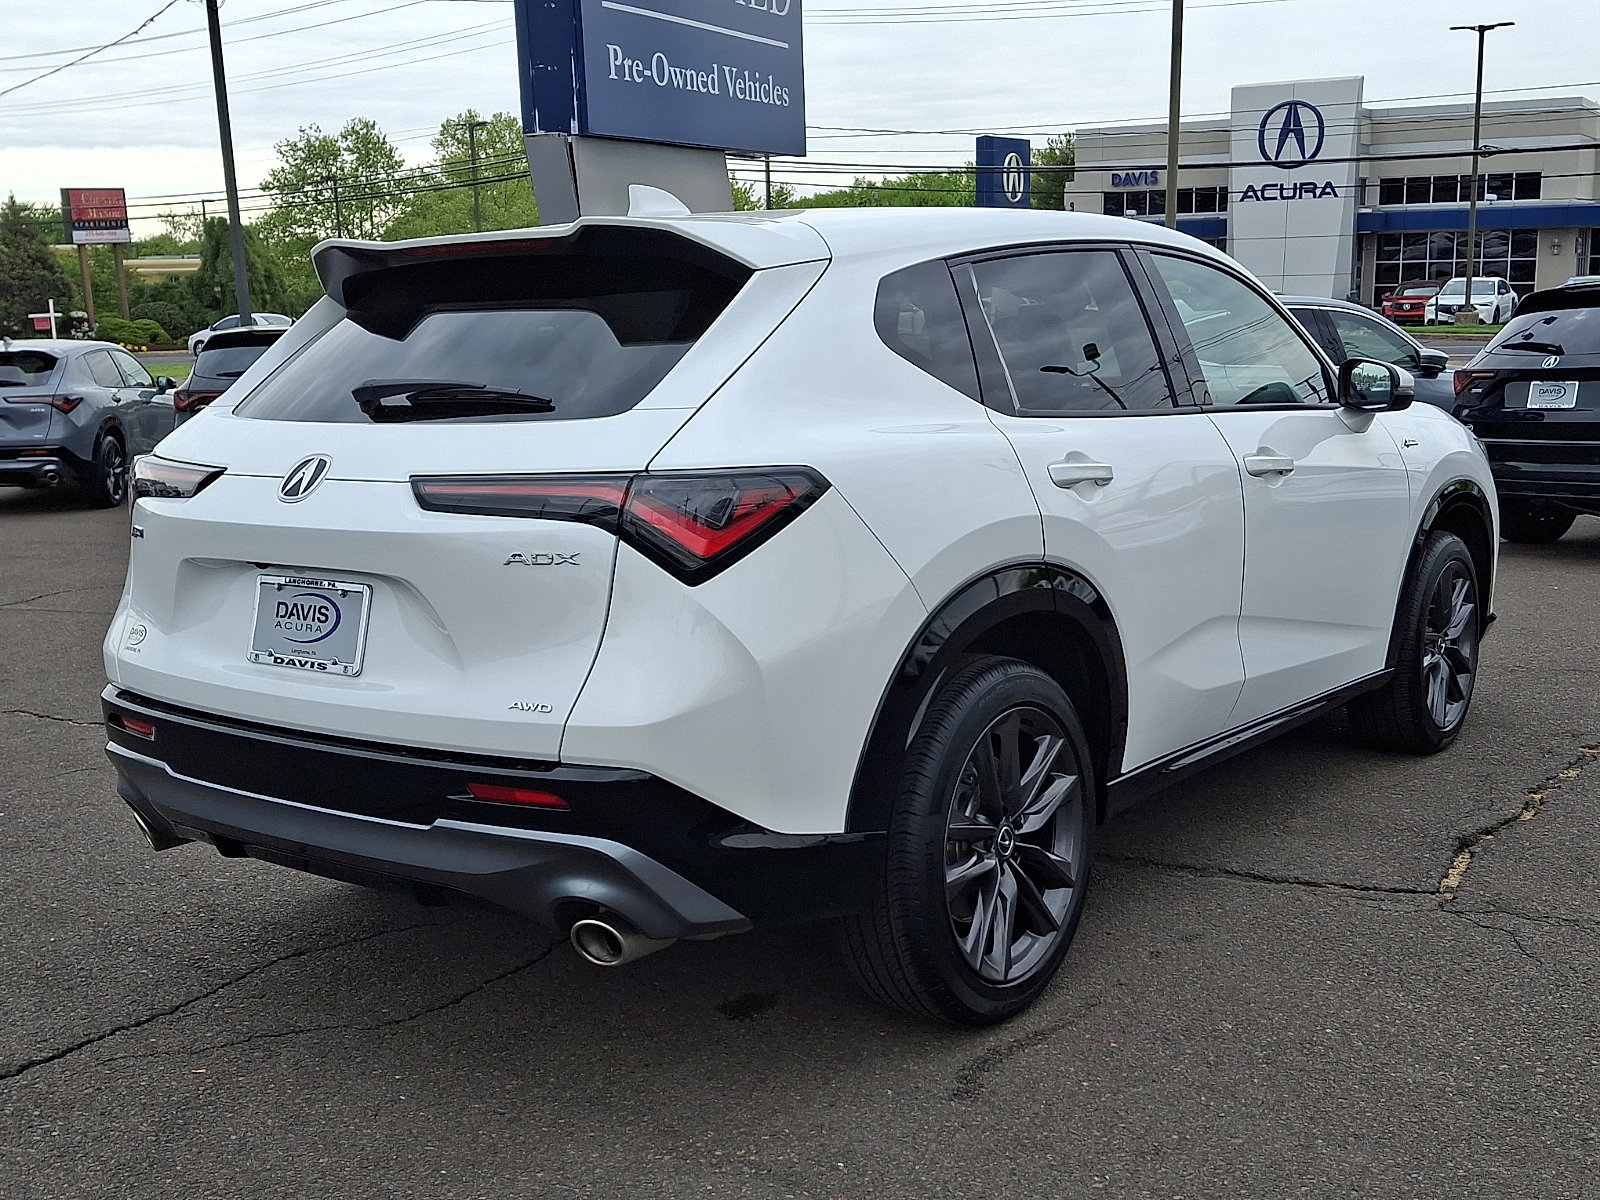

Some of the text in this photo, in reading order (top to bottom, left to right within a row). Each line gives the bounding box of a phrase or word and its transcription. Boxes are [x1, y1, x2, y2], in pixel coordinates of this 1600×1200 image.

[606, 44, 790, 107] Pre-Owned Vehicles
[1111, 170, 1159, 187] DAVIS
[1239, 181, 1338, 202] ACURA
[503, 552, 580, 565] ADX
[275, 601, 329, 624] DAVIS
[274, 621, 323, 634] ACURA
[273, 656, 328, 671] DAVIS
[508, 701, 553, 713] AWD
